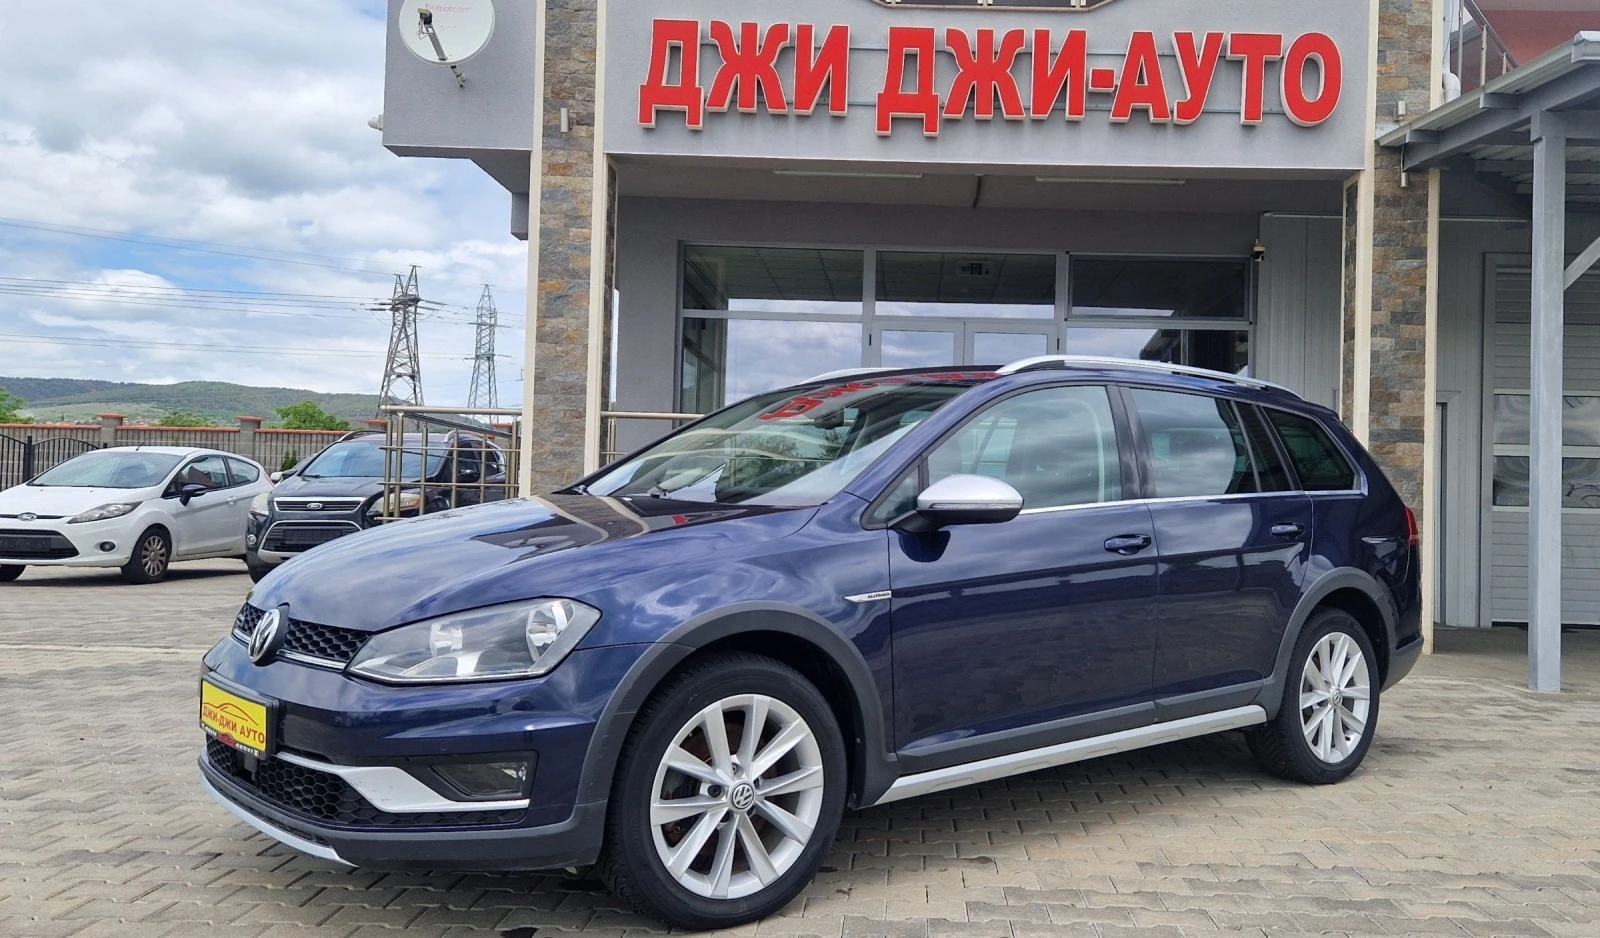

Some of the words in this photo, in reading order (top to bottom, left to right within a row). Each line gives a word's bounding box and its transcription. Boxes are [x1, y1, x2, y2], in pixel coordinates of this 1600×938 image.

[638, 18, 850, 130] ДЖИ
[875, 26, 1343, 137] ДЖИ-АУТО
[202, 705, 237, 733] ДЖИ-ДЖИ
[239, 724, 265, 744] АУТО
